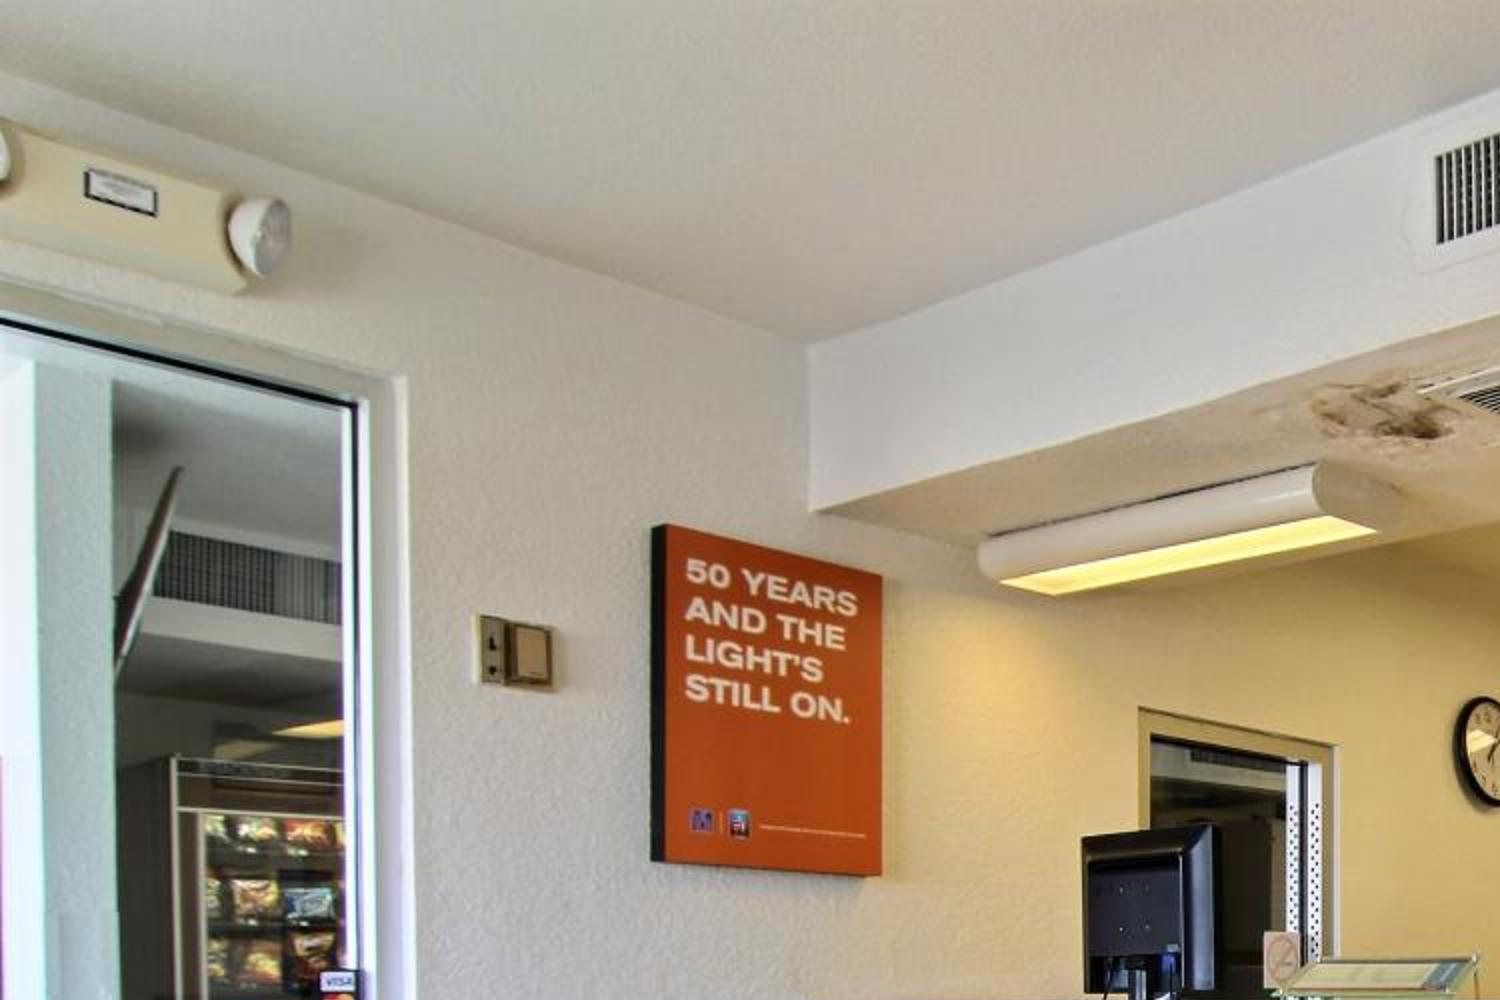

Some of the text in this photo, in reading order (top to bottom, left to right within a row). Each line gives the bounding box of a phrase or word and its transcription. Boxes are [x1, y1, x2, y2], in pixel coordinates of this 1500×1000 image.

[686, 557, 858, 617] 50 YEARS
[685, 596, 846, 650] AND THE
[685, 634, 824, 682] LIGHT'S
[685, 674, 850, 724] STILL ON.
[326, 977, 353, 987] VISA
